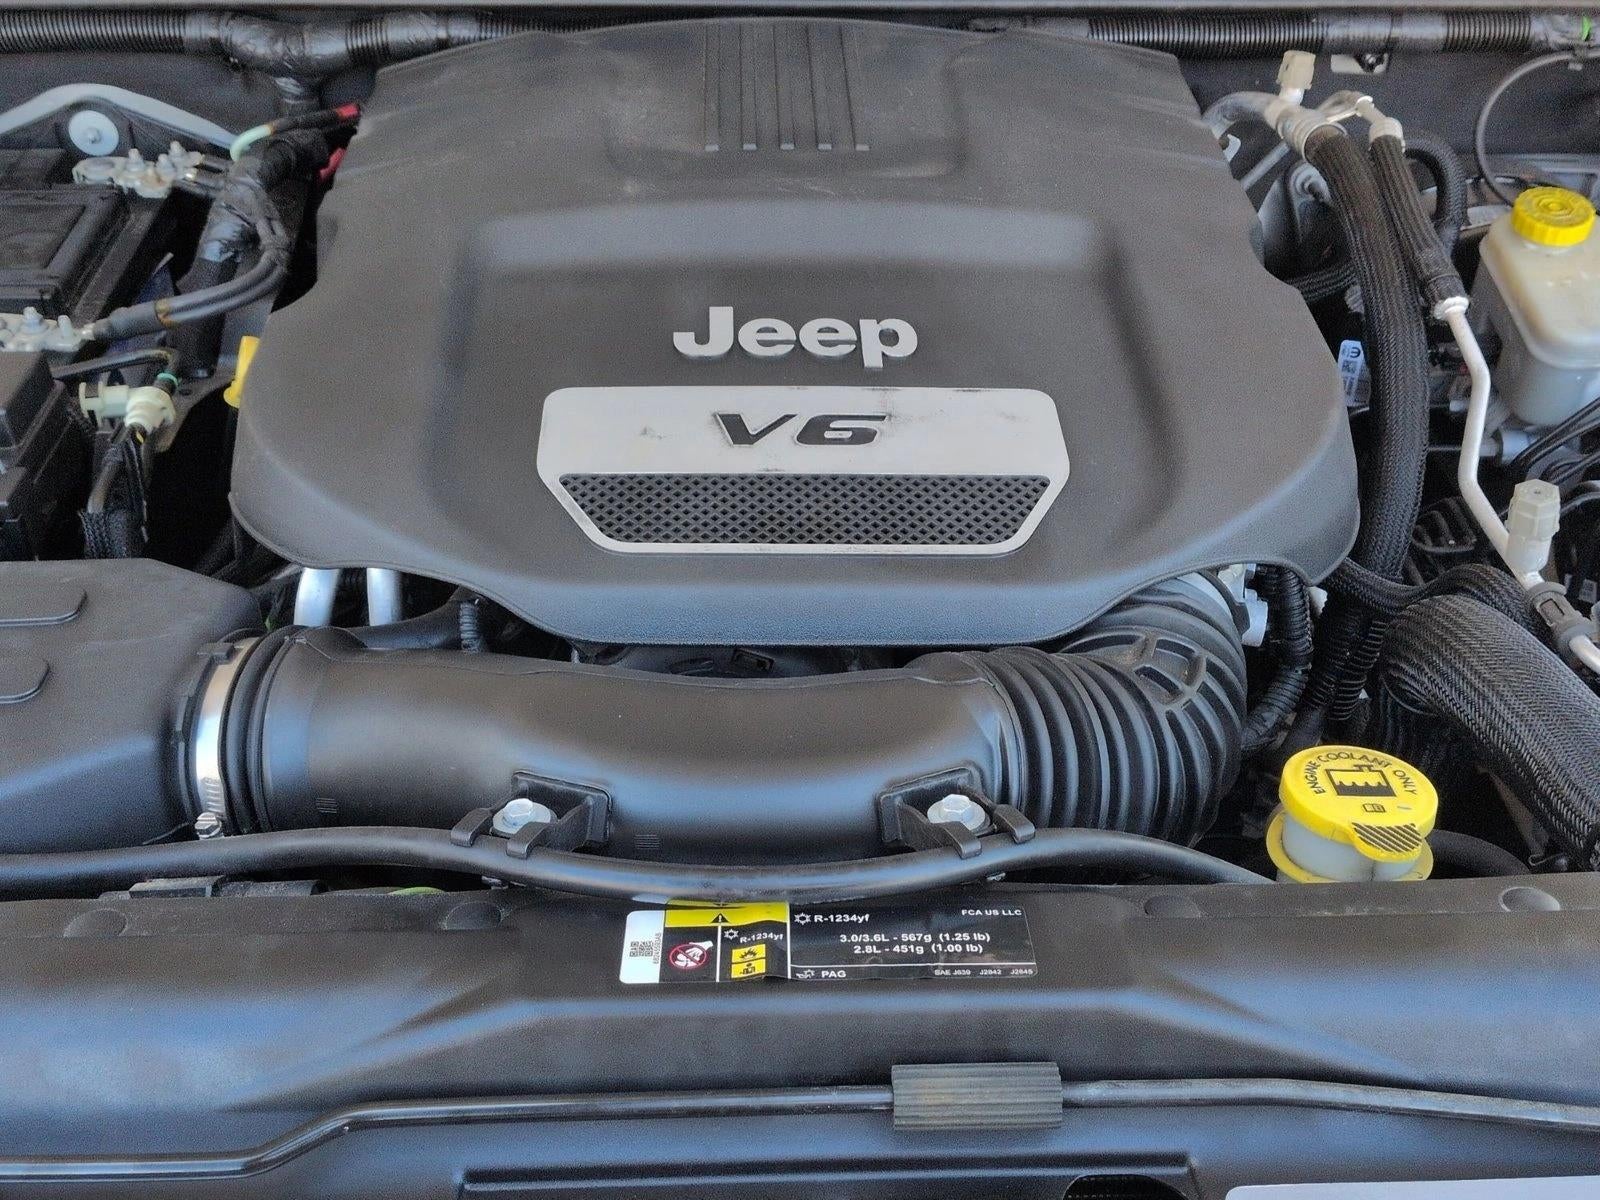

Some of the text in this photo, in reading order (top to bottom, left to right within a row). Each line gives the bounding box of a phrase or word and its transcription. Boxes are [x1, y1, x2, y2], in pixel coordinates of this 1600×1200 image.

[672, 306, 918, 368] Jeep
[716, 413, 888, 446] V6
[1304, 751, 1417, 795] ENGINE COOLANT ONLY
[813, 913, 870, 924] R-1234yf
[739, 932, 784, 944] R-1234yf
[839, 933, 890, 943] 3.0/3.6L
[901, 933, 932, 944] 567g
[938, 932, 971, 943] (1.25
[973, 932, 991, 943] lb)
[853, 944, 882, 954] 2.8L
[892, 944, 924, 955] 451g
[931, 943, 963, 954] (1.00
[965, 943, 984, 954] lb)
[821, 970, 847, 978] PAG
